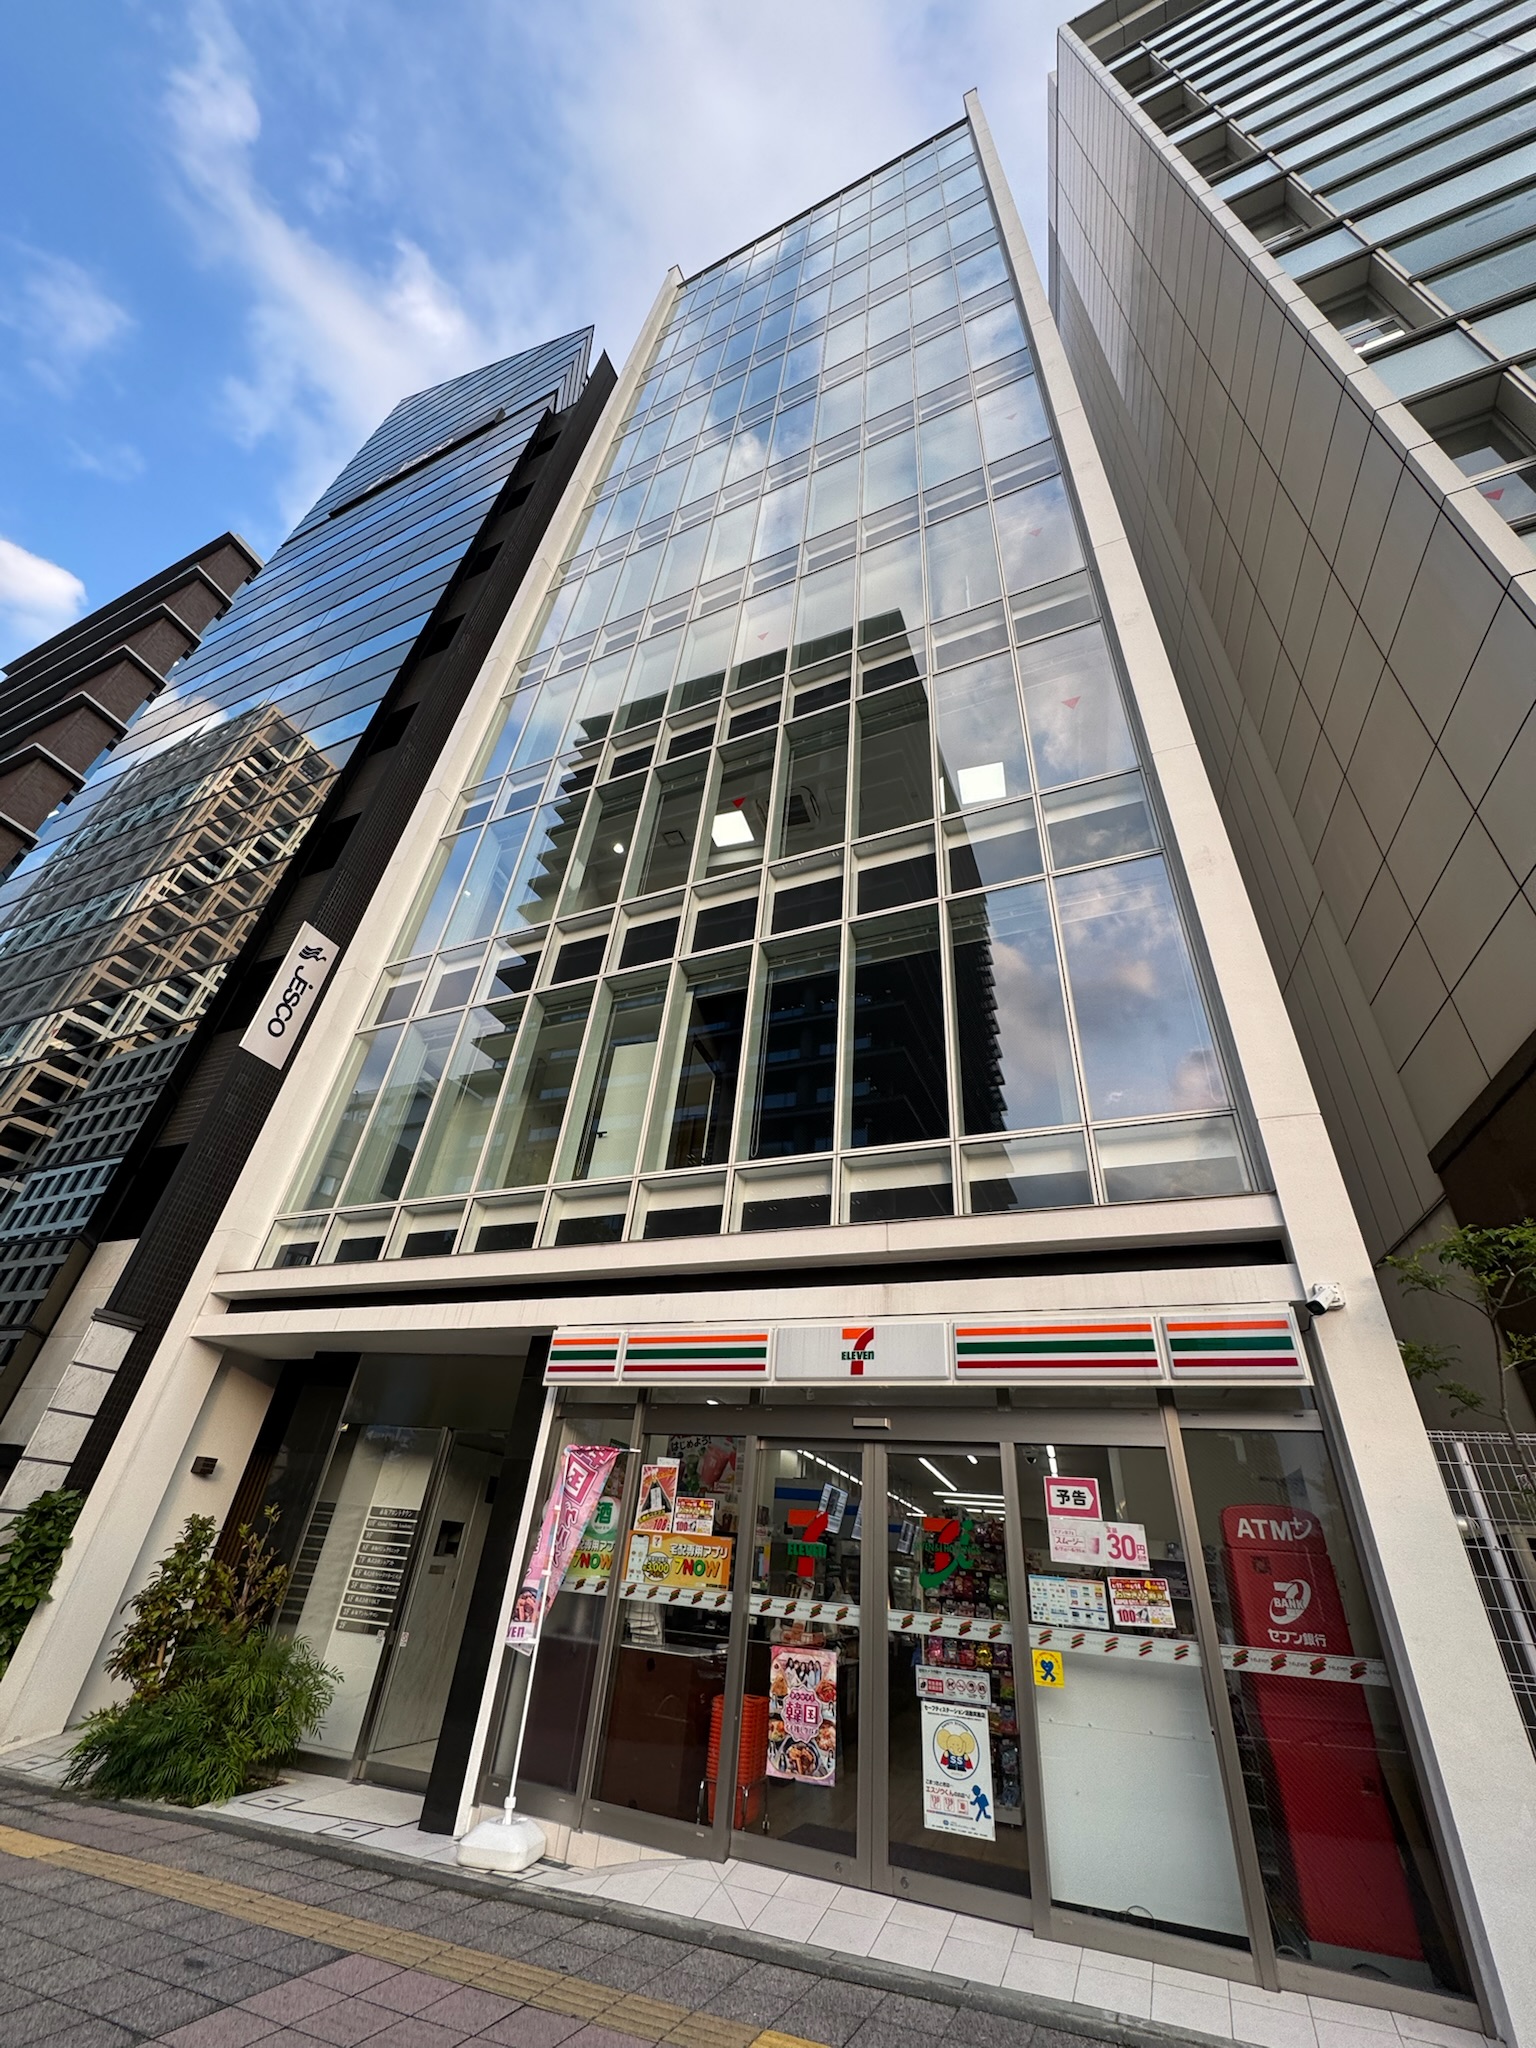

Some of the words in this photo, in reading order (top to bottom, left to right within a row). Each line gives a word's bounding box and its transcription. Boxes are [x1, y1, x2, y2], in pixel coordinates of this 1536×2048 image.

[267, 965, 313, 1038] JESCO
[842, 1327, 875, 1376] 7
[1056, 1489, 1087, 1506] 予告
[594, 1501, 613, 1524] 酒
[1237, 1517, 1293, 1542] ATM
[670, 1542, 729, 1559] 宅配専用アプリ
[1273, 1597, 1305, 1610] BANK
[1117, 1608, 1136, 1623] 100
[1267, 1628, 1327, 1648] セブン銀行
[786, 1701, 818, 1725] 韓国
[950, 1755, 963, 1765] SS
